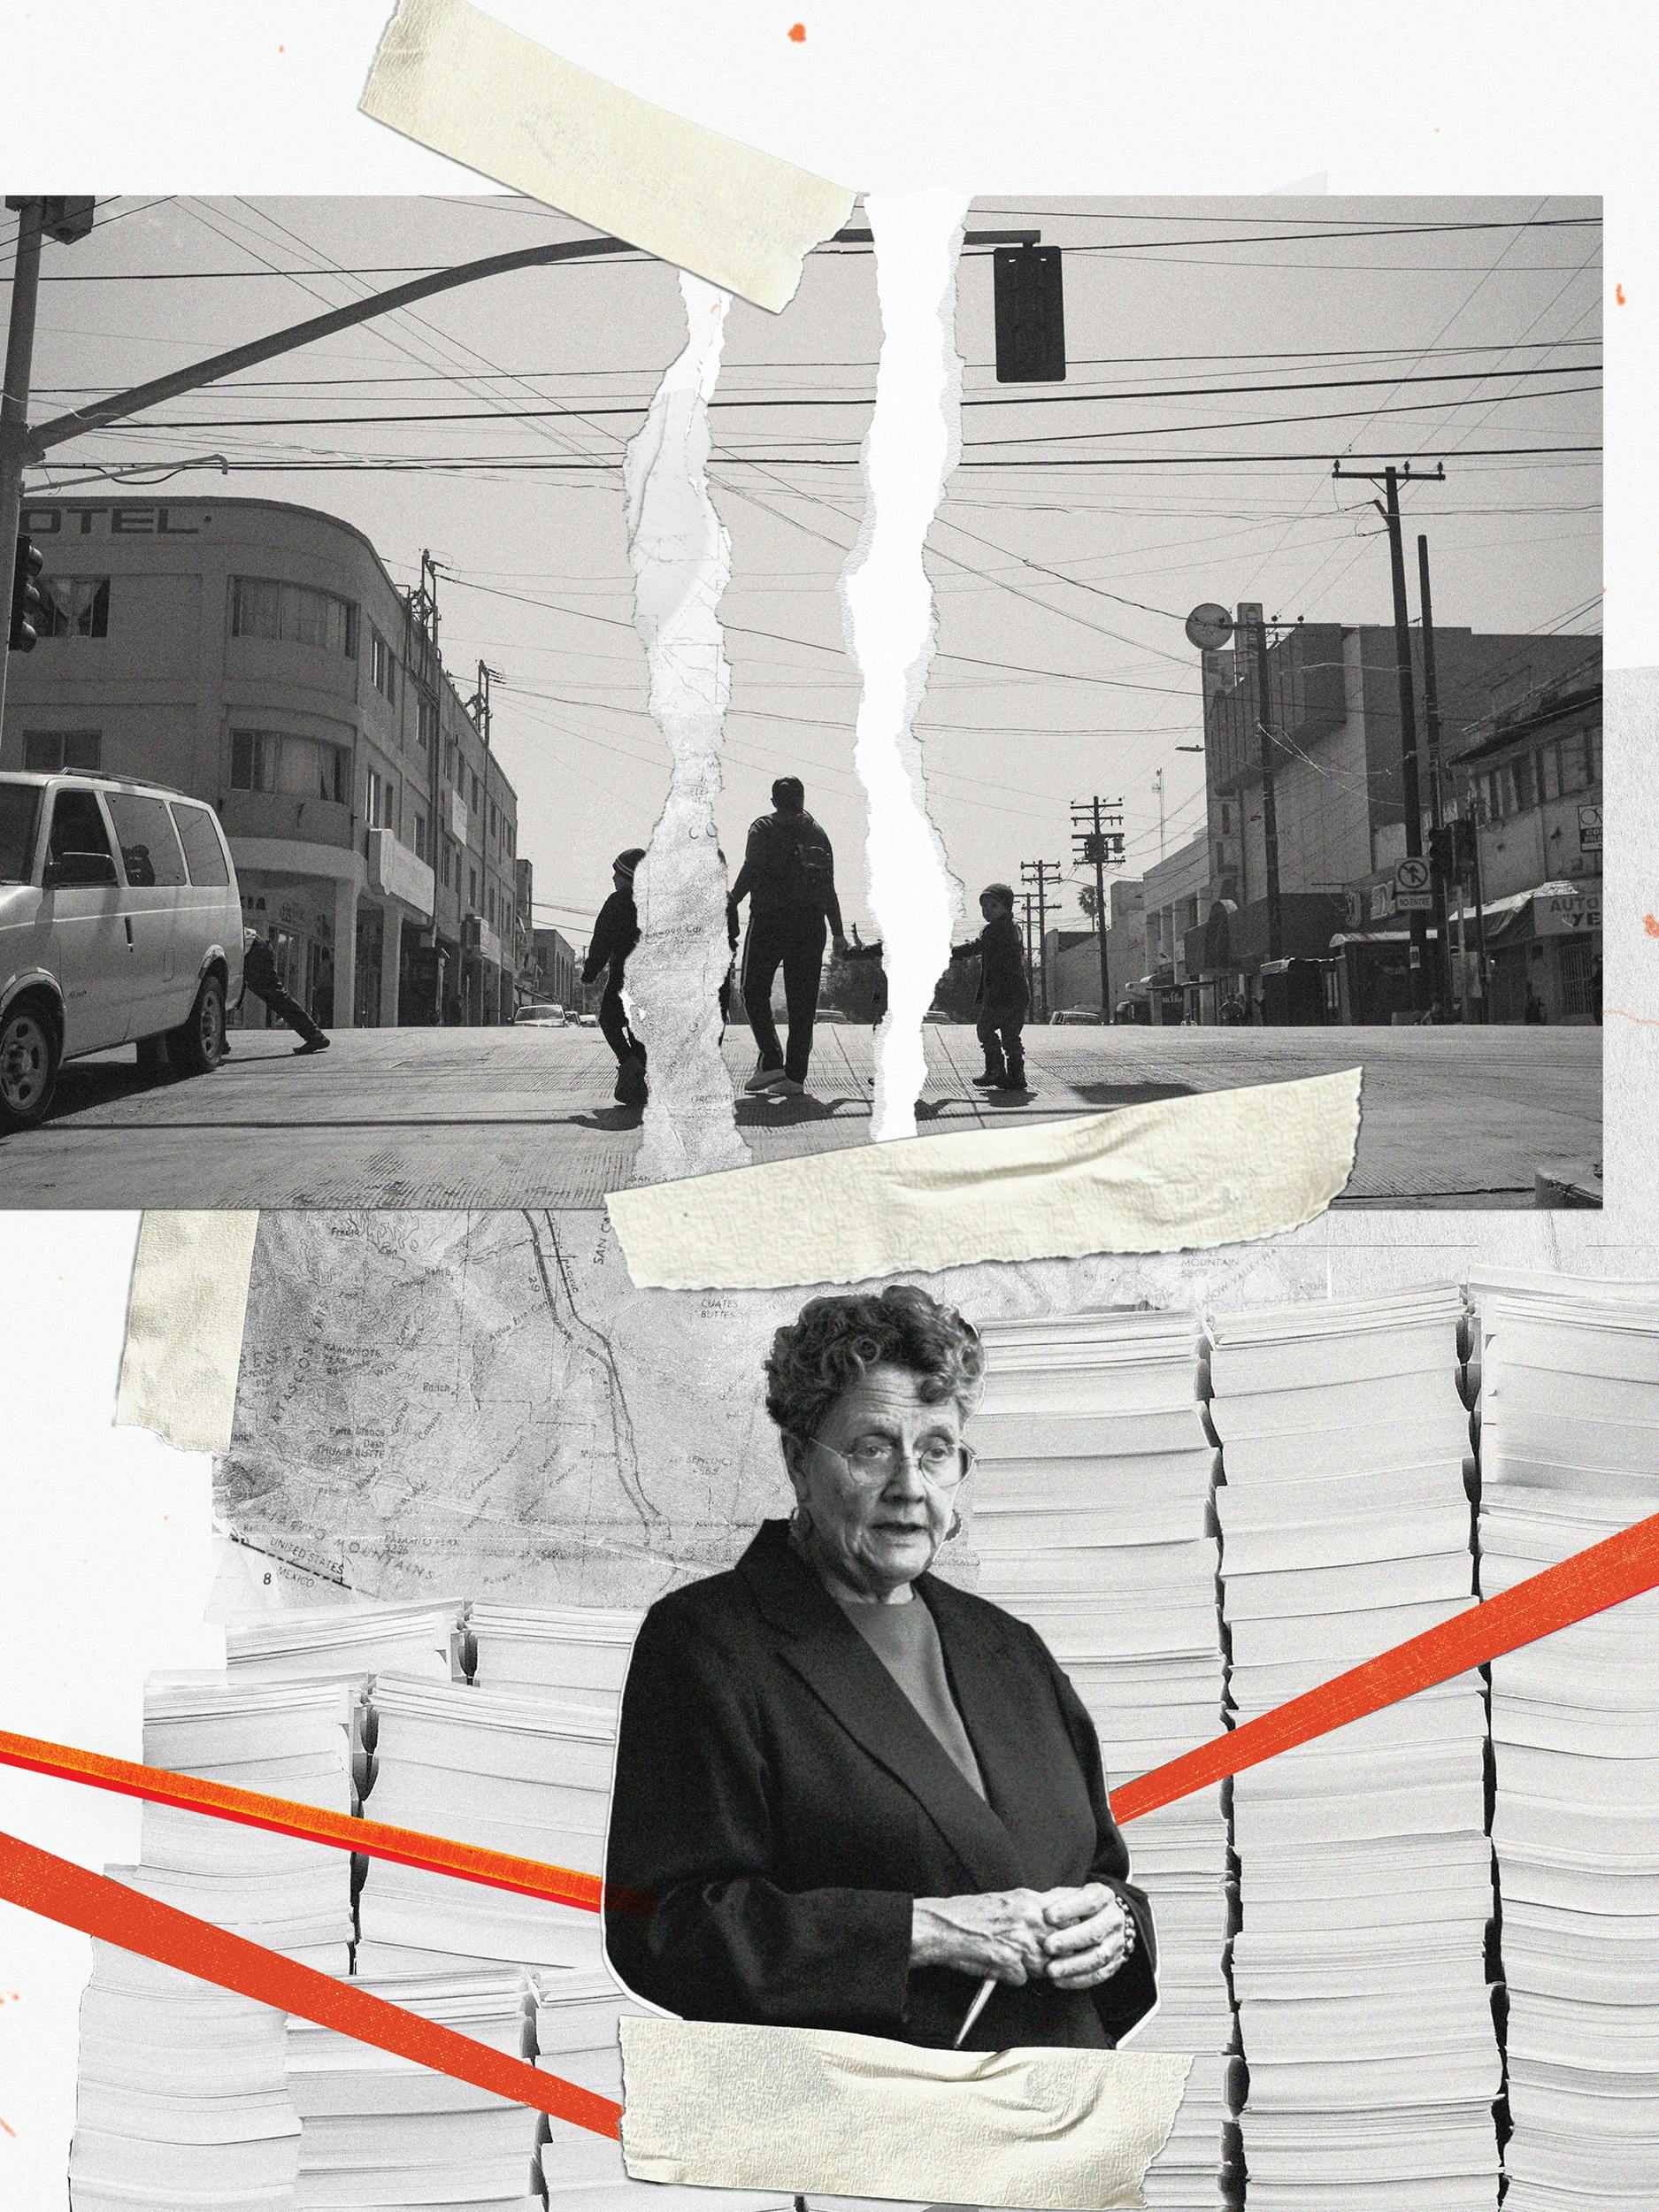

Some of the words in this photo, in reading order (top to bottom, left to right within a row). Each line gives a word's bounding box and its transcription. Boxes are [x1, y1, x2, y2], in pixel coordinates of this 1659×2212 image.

[19, 509, 200, 534] OTEL
[593, 1237, 607, 1265] SAN
[423, 1382, 450, 1393] Ranch
[270, 1537, 307, 1559] UNITED
[307, 1552, 345, 1575] STATES
[263, 1572, 272, 1586] 8
[279, 1566, 315, 1588] MEXICO
